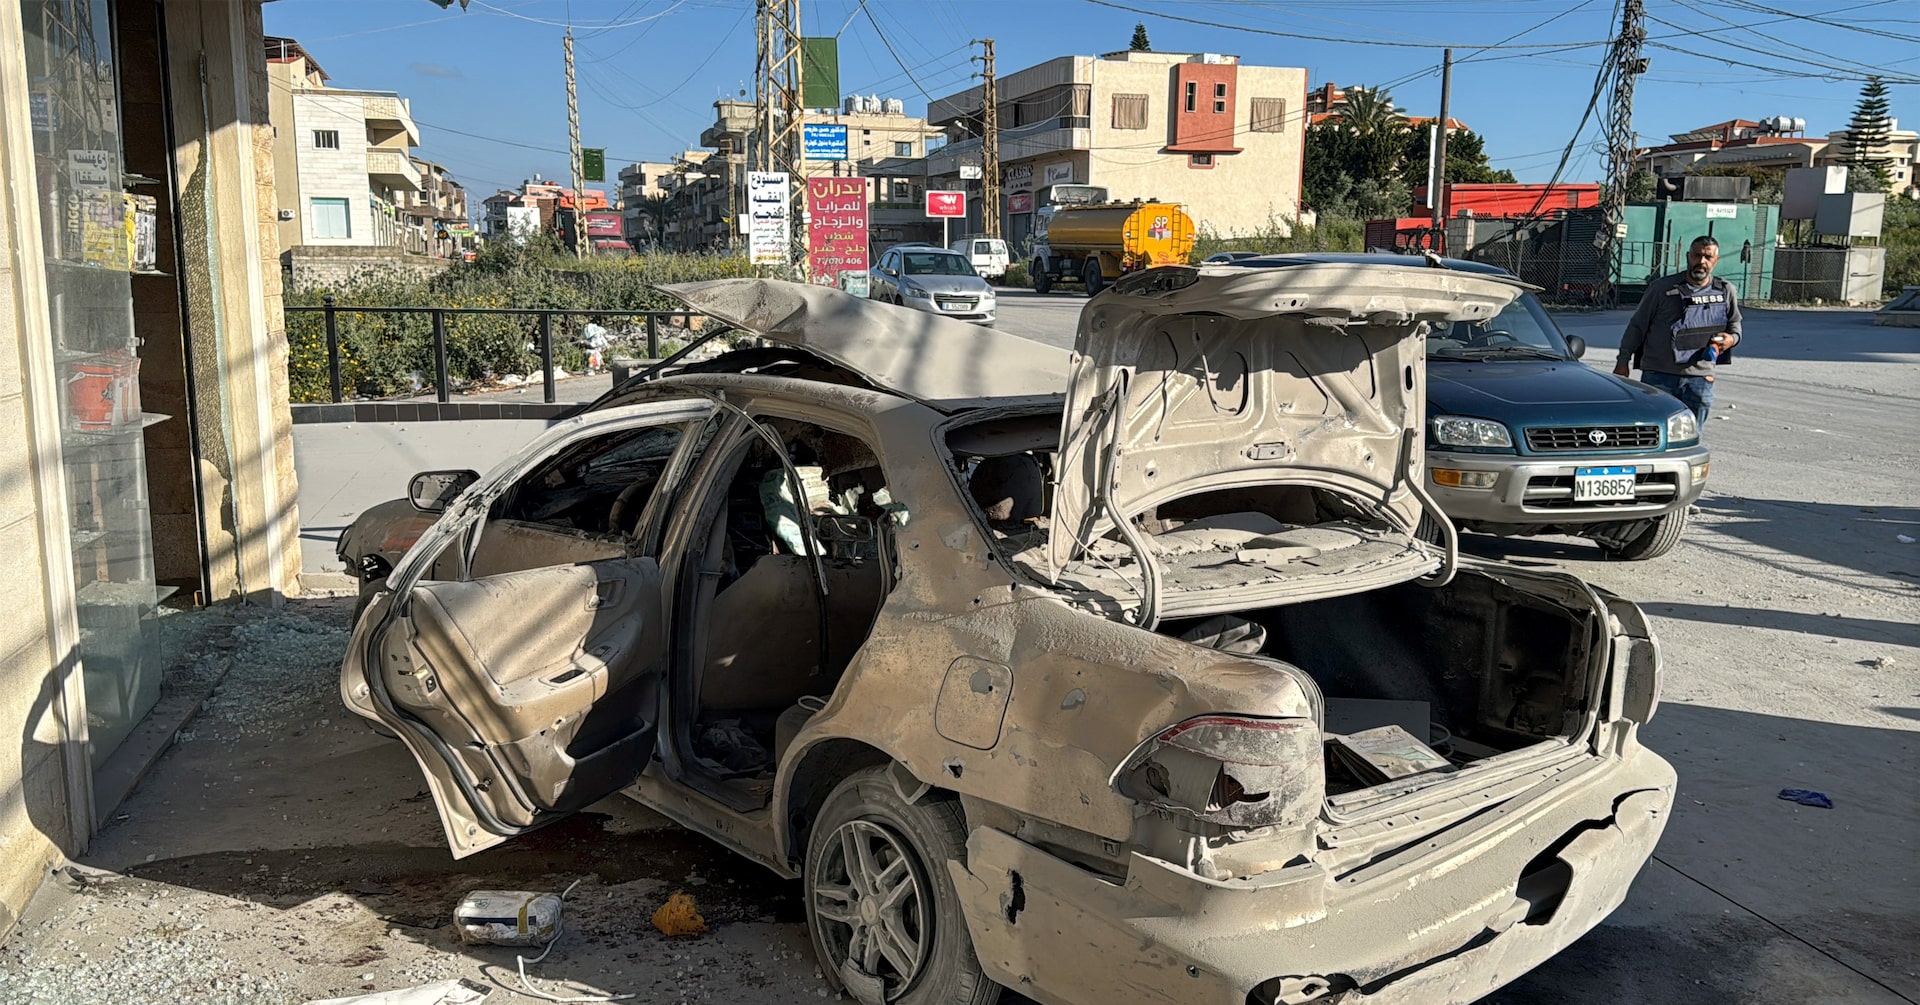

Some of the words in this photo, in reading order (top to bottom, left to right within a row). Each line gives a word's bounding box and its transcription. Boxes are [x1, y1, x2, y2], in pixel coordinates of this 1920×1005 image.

[751, 172, 784, 190] مستودع
[813, 179, 863, 199] بدران
[753, 191, 784, 207] الفقيه
[816, 200, 861, 214] للمرايا
[813, 215, 864, 230] والزجاج
[845, 257, 863, 265] 406
[1575, 479, 1635, 498] N136852
